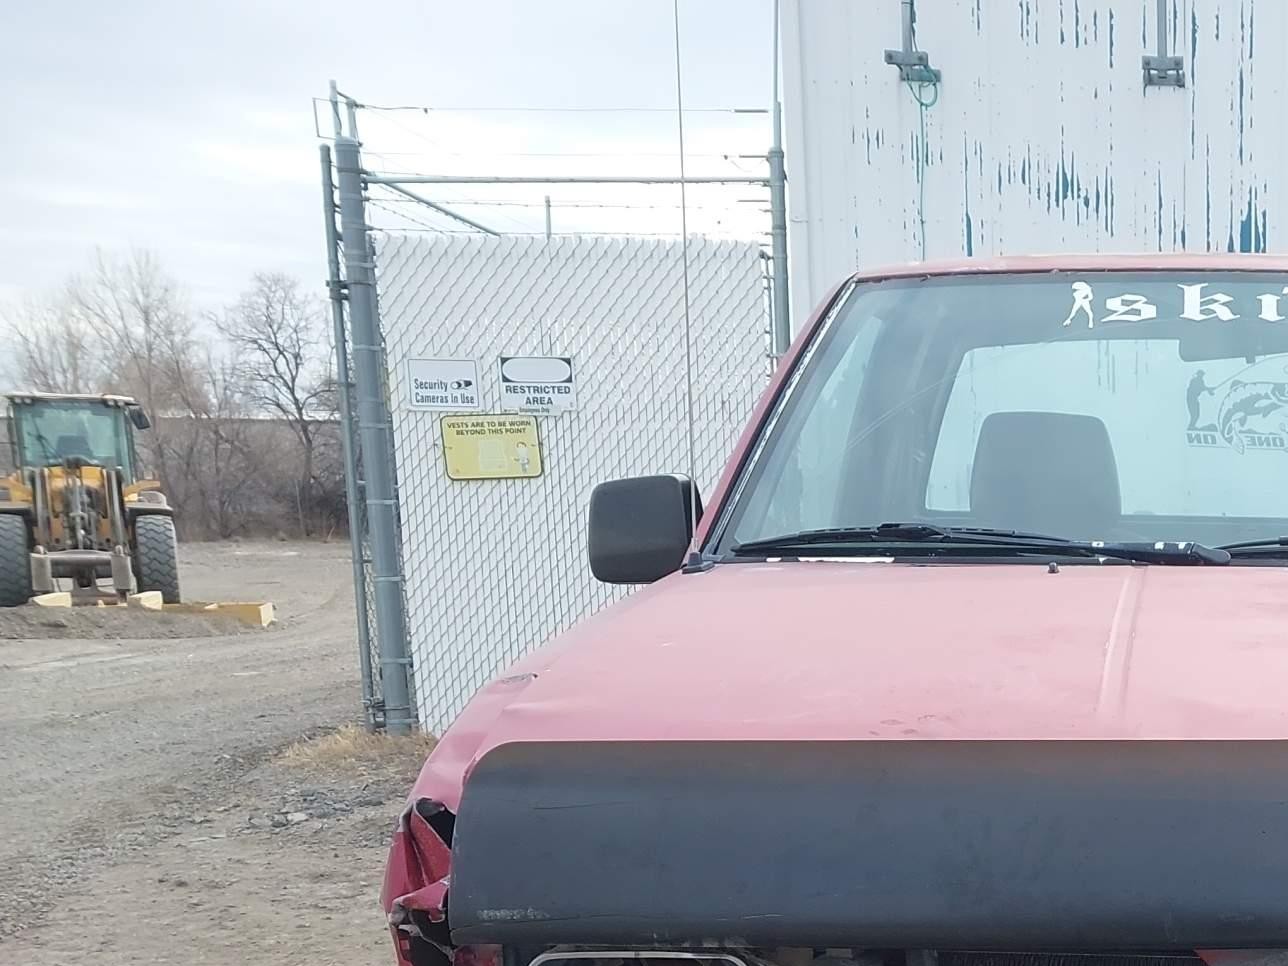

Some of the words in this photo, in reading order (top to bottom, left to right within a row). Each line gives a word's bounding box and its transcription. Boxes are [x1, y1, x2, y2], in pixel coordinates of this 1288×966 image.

[414, 378, 448, 392] Security
[505, 385, 571, 394] RESTRICTED
[415, 392, 449, 403] Cameras
[451, 393, 459, 403] In
[461, 393, 475, 404] Use
[525, 396, 554, 405] AREA
